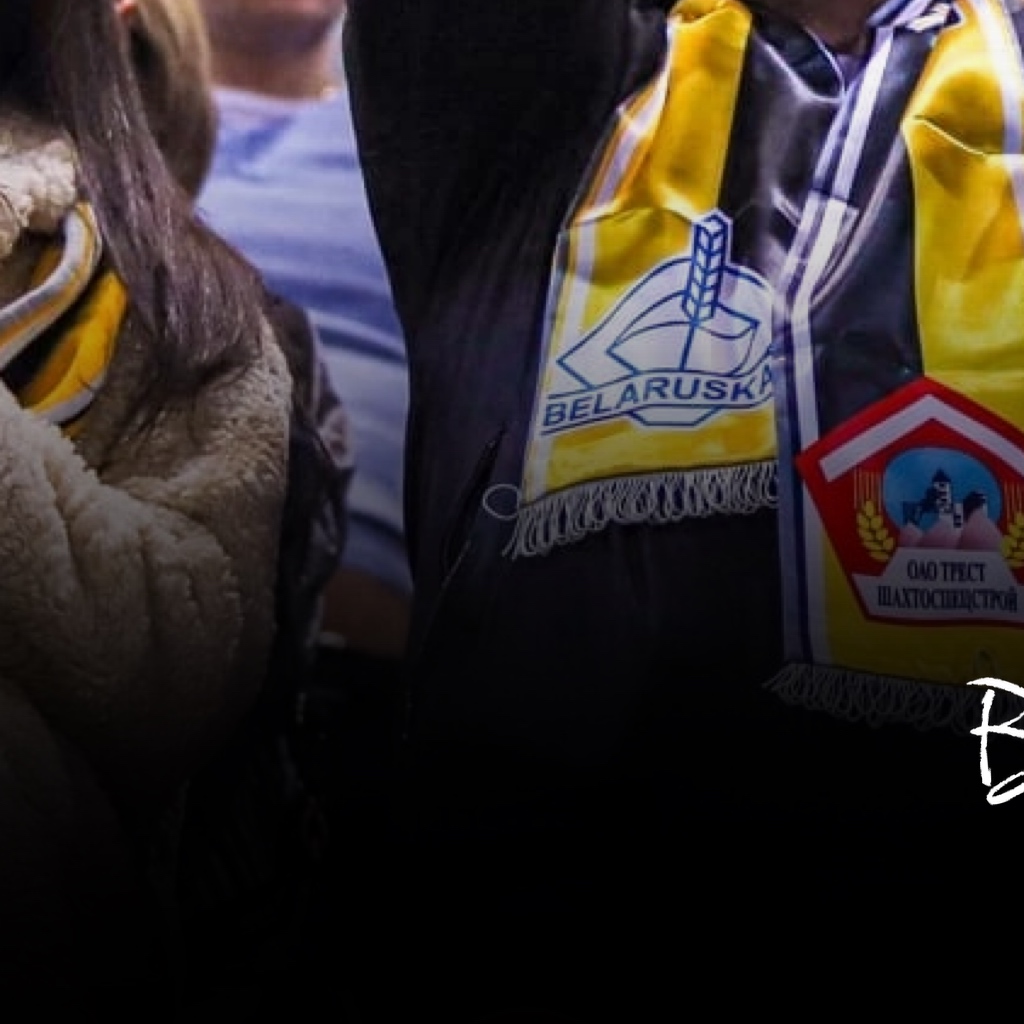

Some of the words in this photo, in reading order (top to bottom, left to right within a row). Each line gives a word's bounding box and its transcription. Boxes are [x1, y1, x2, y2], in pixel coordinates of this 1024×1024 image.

[907, 559, 937, 581] ОАО
[940, 561, 986, 583] ТРЕСТ
[877, 584, 1018, 613] ШАХТОСПЕЦСТРОЙ
